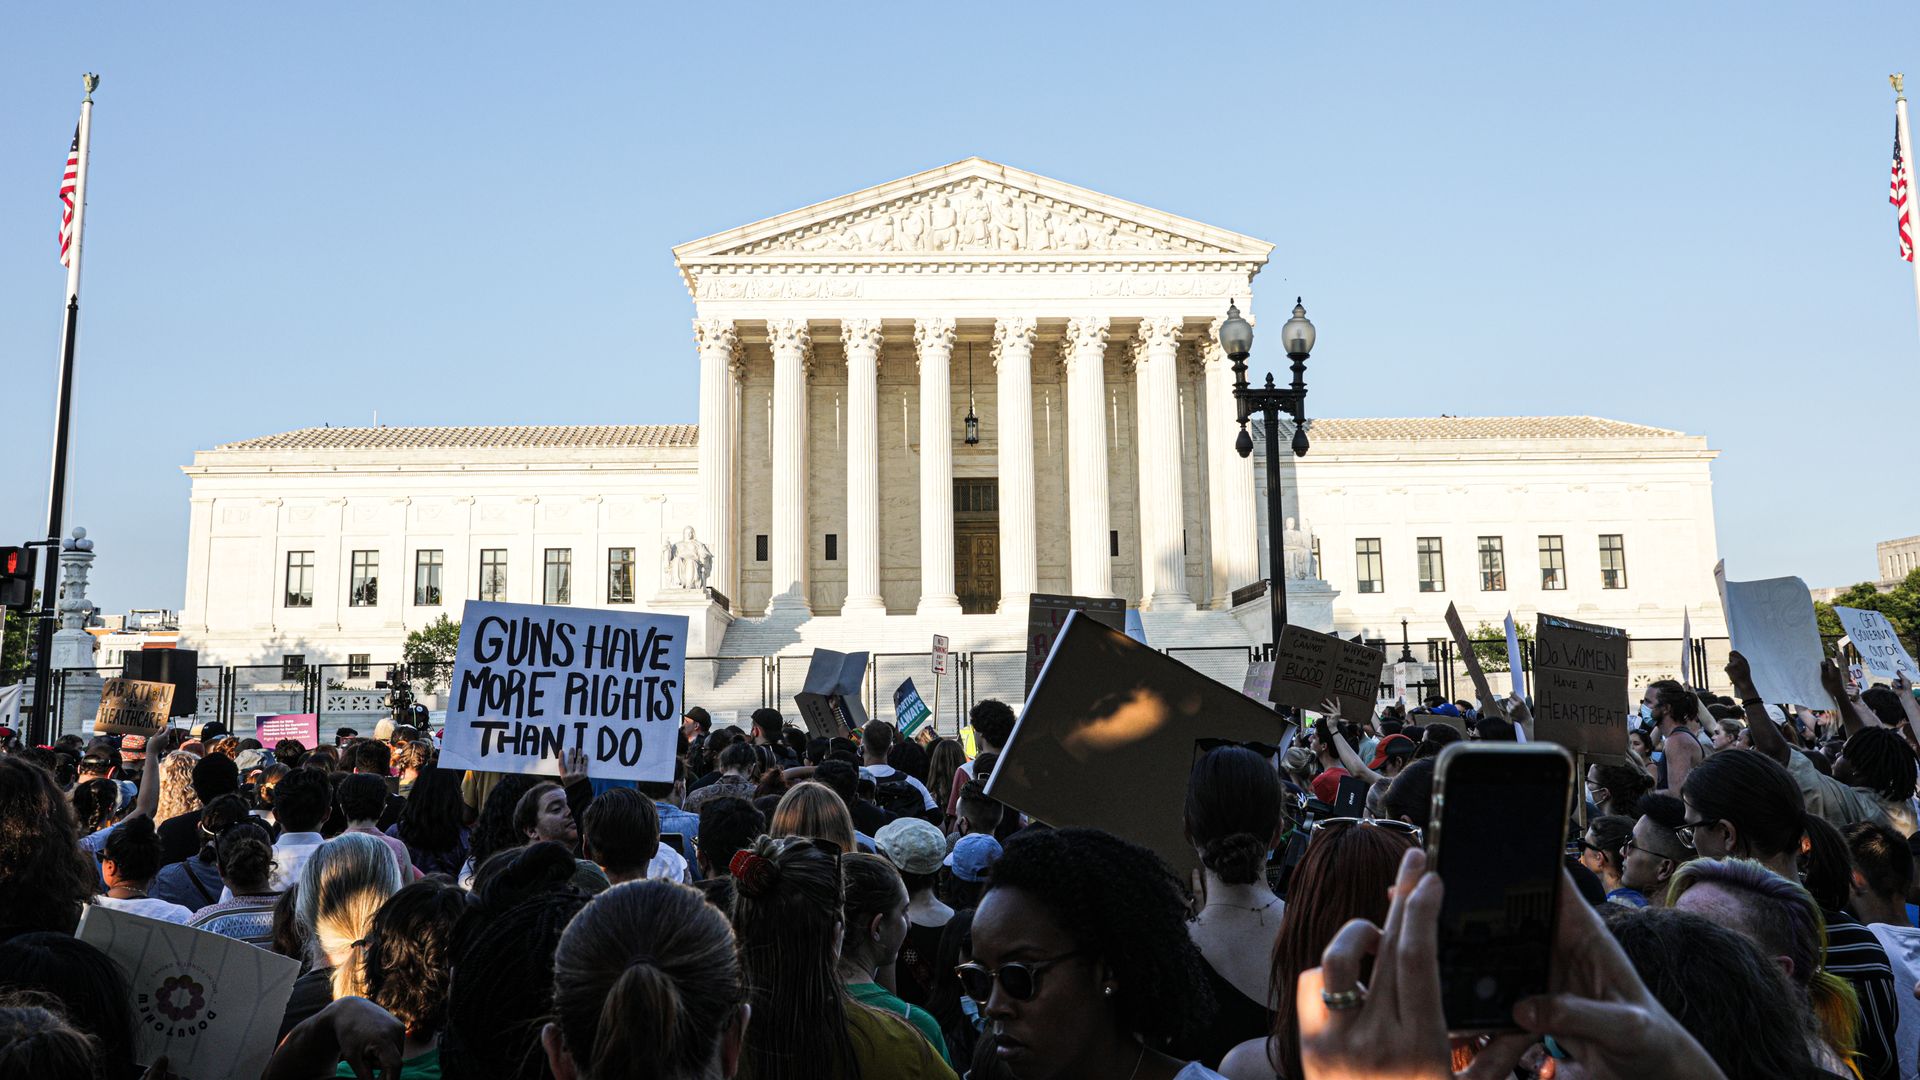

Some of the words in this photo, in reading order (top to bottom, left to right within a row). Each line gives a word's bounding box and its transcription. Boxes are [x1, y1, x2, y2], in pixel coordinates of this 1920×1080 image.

[1860, 612, 1877, 628] GET
[474, 615, 576, 667] GUNS
[582, 625, 673, 673] HAVE
[1293, 640, 1324, 654] CANNOT
[1343, 644, 1362, 656] WHY
[1362, 648, 1376, 661] CAN
[1562, 642, 1616, 672] WOMEN
[1286, 662, 1324, 682] BLOOD
[1553, 674, 1577, 689] HAVE
[1586, 679, 1594, 692] A
[458, 666, 556, 718] MORE
[564, 671, 677, 722] RIGHTS
[100, 708, 163, 729] HEALTHCARE
[898, 700, 924, 732] ALWAYS
[1539, 689, 1624, 728] HEARTBEAT
[470, 721, 565, 760] THAN
[574, 722, 588, 762] I
[597, 725, 643, 766] DO
